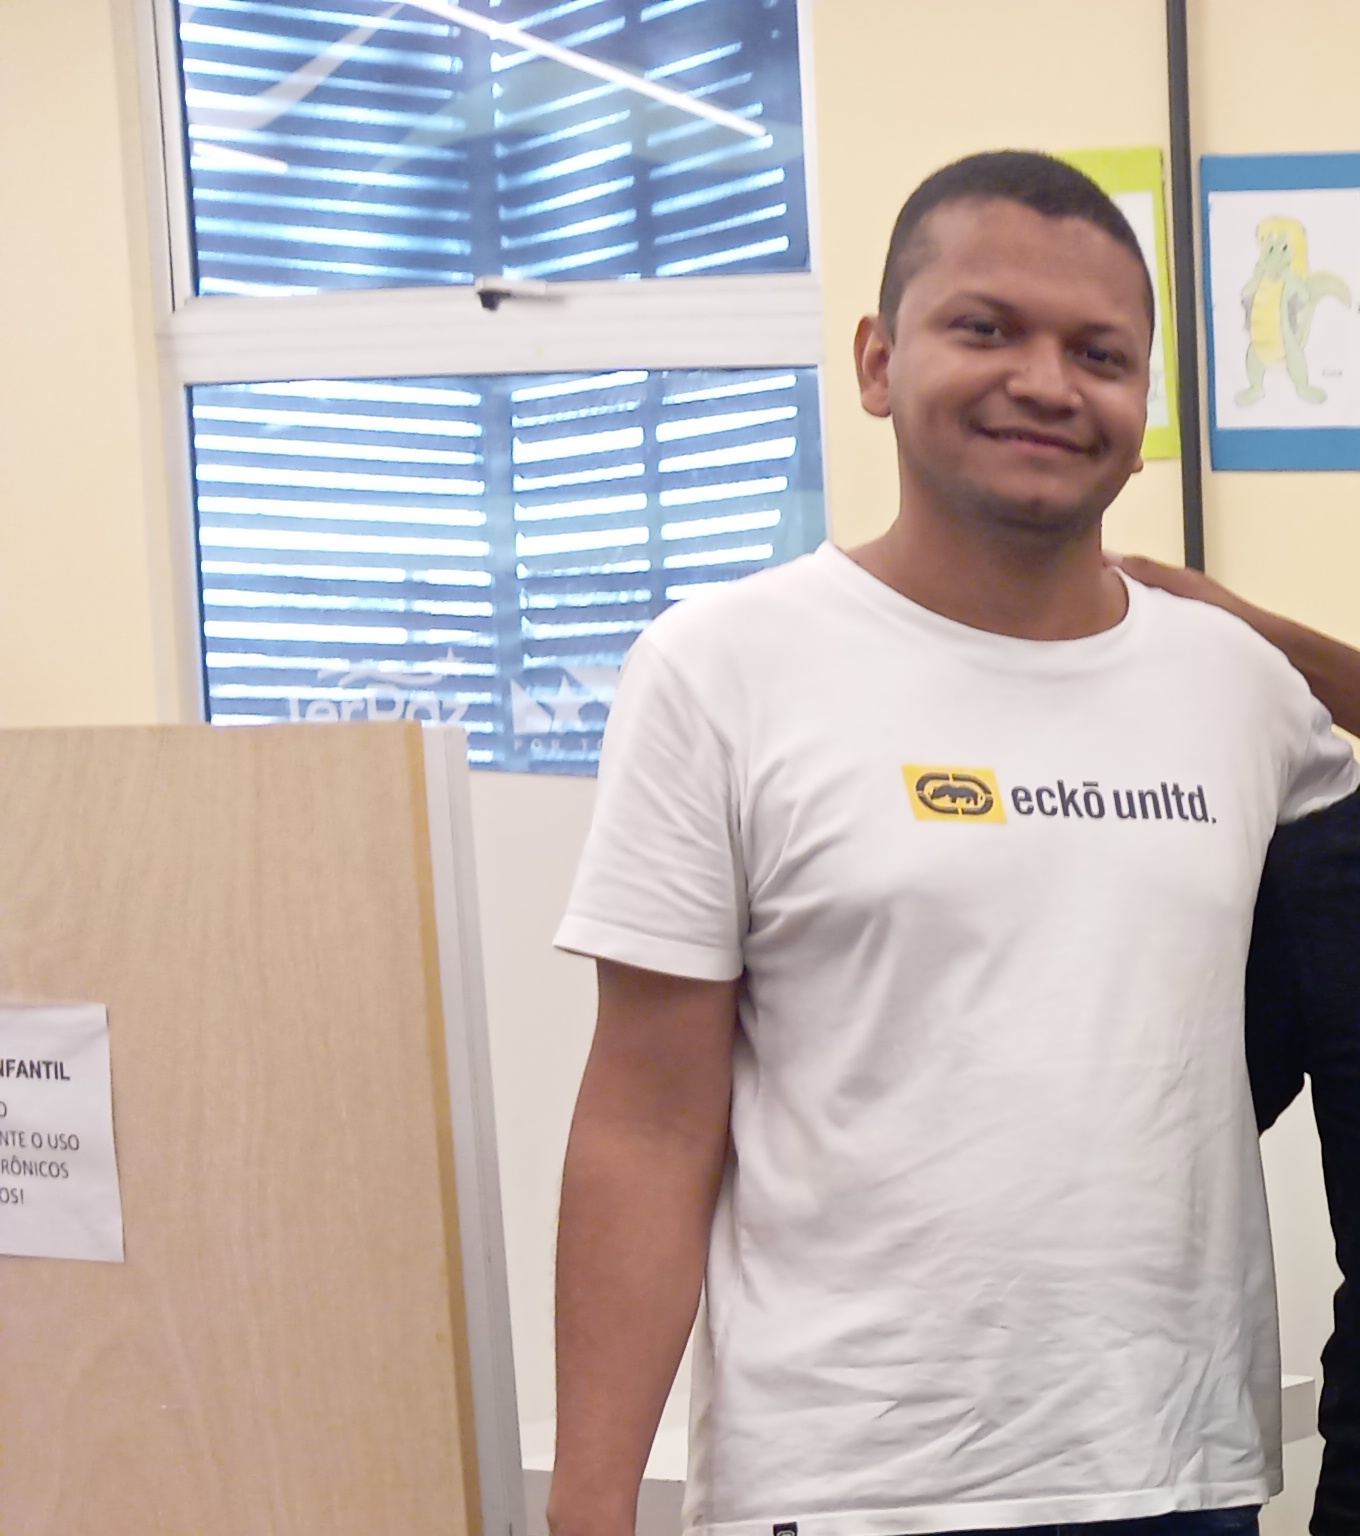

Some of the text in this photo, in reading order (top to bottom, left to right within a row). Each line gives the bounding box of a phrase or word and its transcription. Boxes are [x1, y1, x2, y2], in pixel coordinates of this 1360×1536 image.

[1010, 779, 1218, 824] eckō unltd.
[31, 1131, 43, 1149] O
[47, 1132, 80, 1151] USO
[1, 1154, 70, 1179] RÔNICOS
